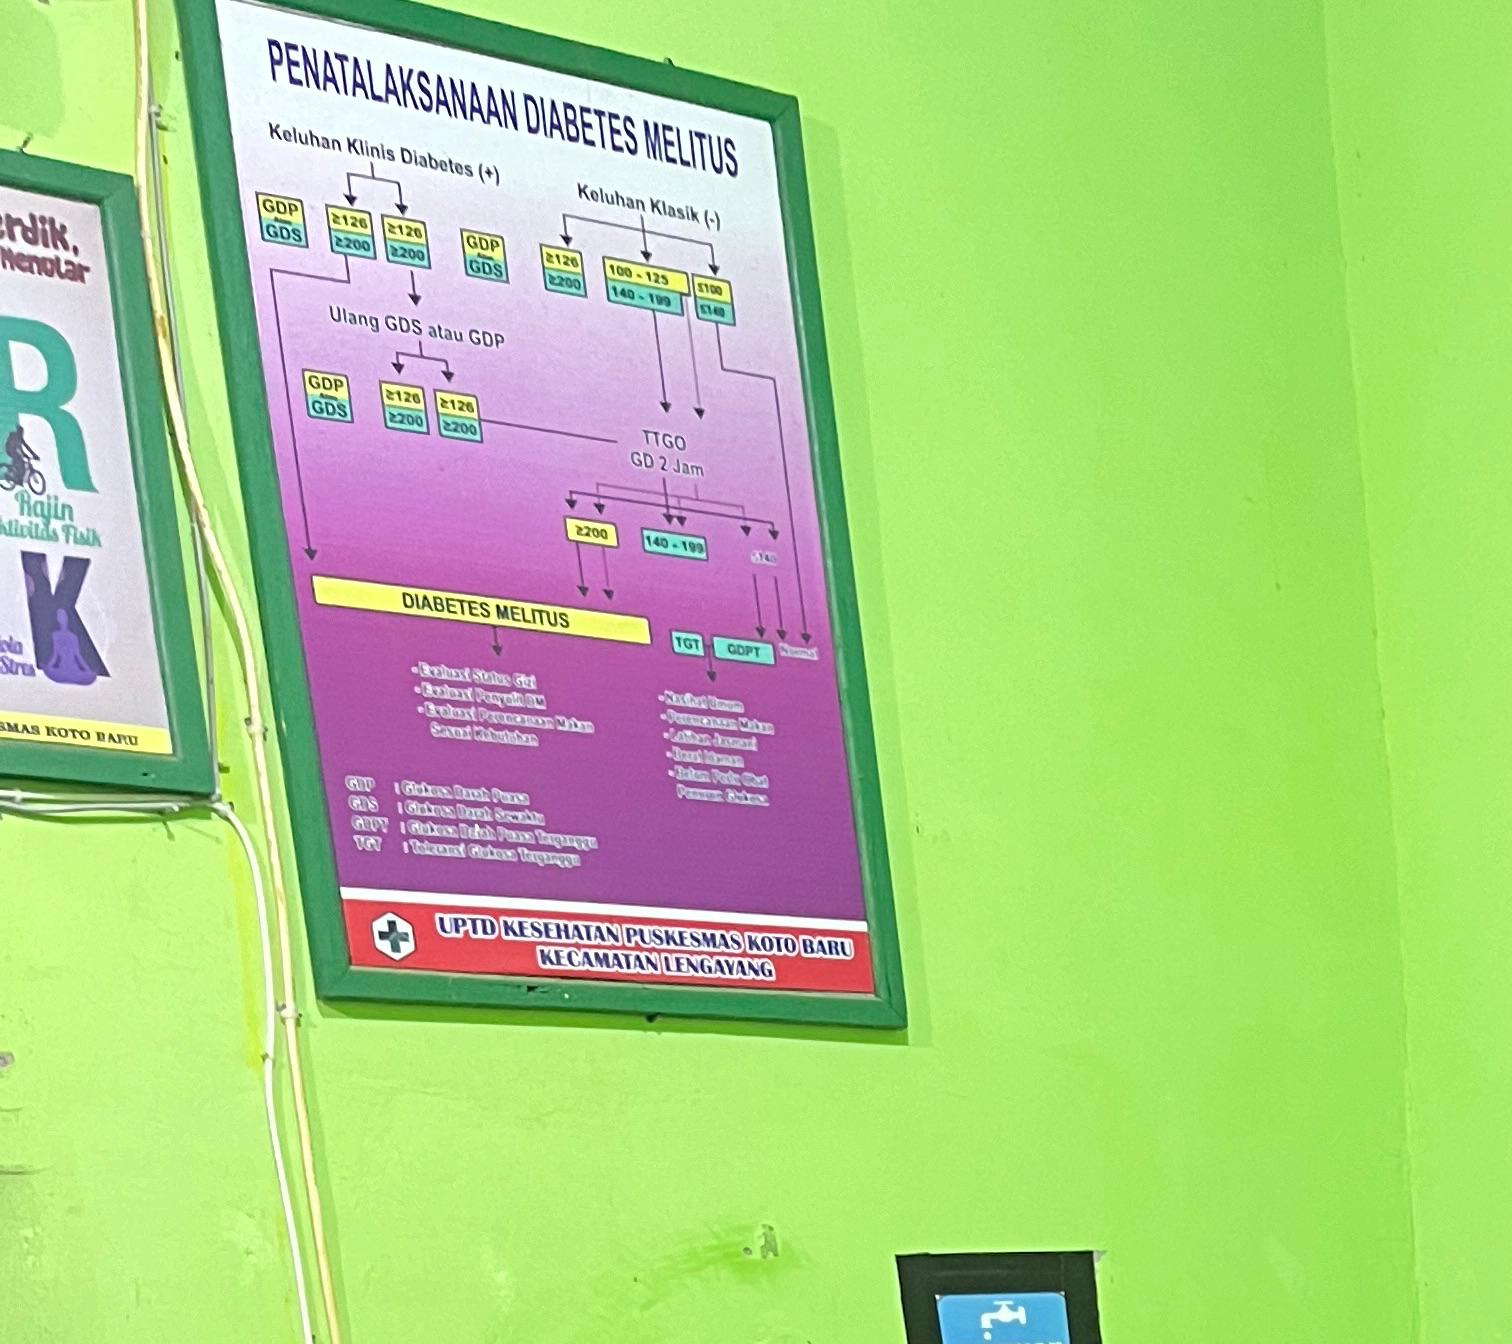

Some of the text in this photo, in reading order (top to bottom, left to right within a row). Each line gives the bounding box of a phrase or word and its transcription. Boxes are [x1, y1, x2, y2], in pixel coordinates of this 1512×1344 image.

[267, 39, 737, 177] PENATALAKSANAAN DIABETES MELITUS
[268, 122, 499, 185] Keluhan Klinis Diabetes (+)
[261, 197, 299, 218] GDP
[577, 183, 645, 211] Keluhan
[650, 198, 699, 222] Klasik
[265, 222, 302, 243] GDS
[466, 234, 500, 253] GDP
[469, 258, 503, 277] GDS
[329, 306, 504, 347] Ulang GDS atau GDP
[307, 374, 344, 393] GDP
[310, 399, 348, 418] GDS
[642, 430, 685, 450] TTGO
[631, 452, 703, 476] GD 2 Jam
[20, 550, 111, 678] K
[402, 592, 569, 628] DIABETES MELITUS
[675, 636, 701, 651] TGT
[436, 913, 853, 960] UPTD KESEHATAN PUSKESMAS KOTO BARU
[537, 946, 775, 982] KECAMATAN LENGAYANG
